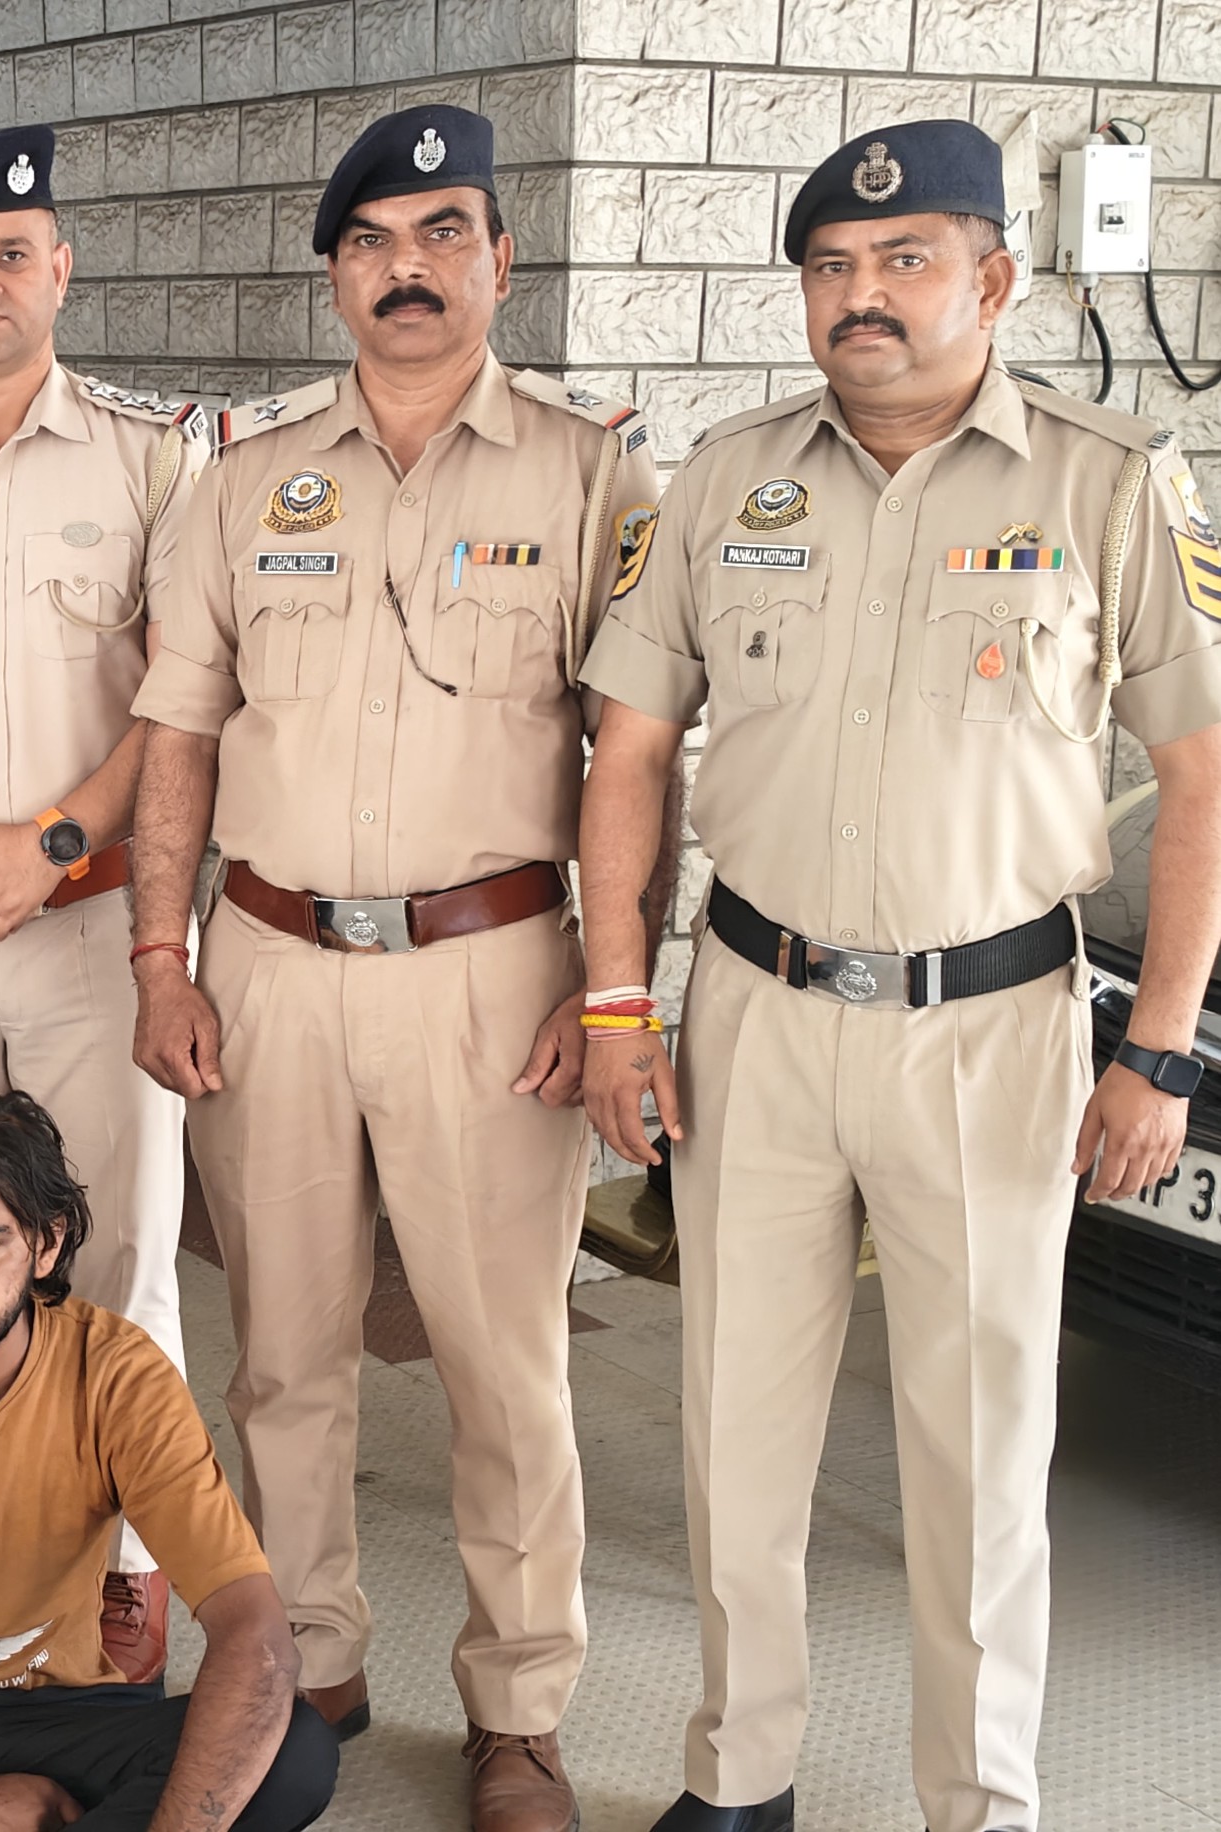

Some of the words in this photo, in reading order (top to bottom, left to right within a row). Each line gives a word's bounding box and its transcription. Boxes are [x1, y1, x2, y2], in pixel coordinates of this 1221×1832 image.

[265, 556, 298, 570] JAGPAL
[299, 556, 327, 571] SINGH
[728, 548, 762, 562] PANKAJ
[762, 549, 800, 565] KOTHARI
[1189, 1168, 1221, 1224] 3
[28, 1648, 49, 1671] FIND
